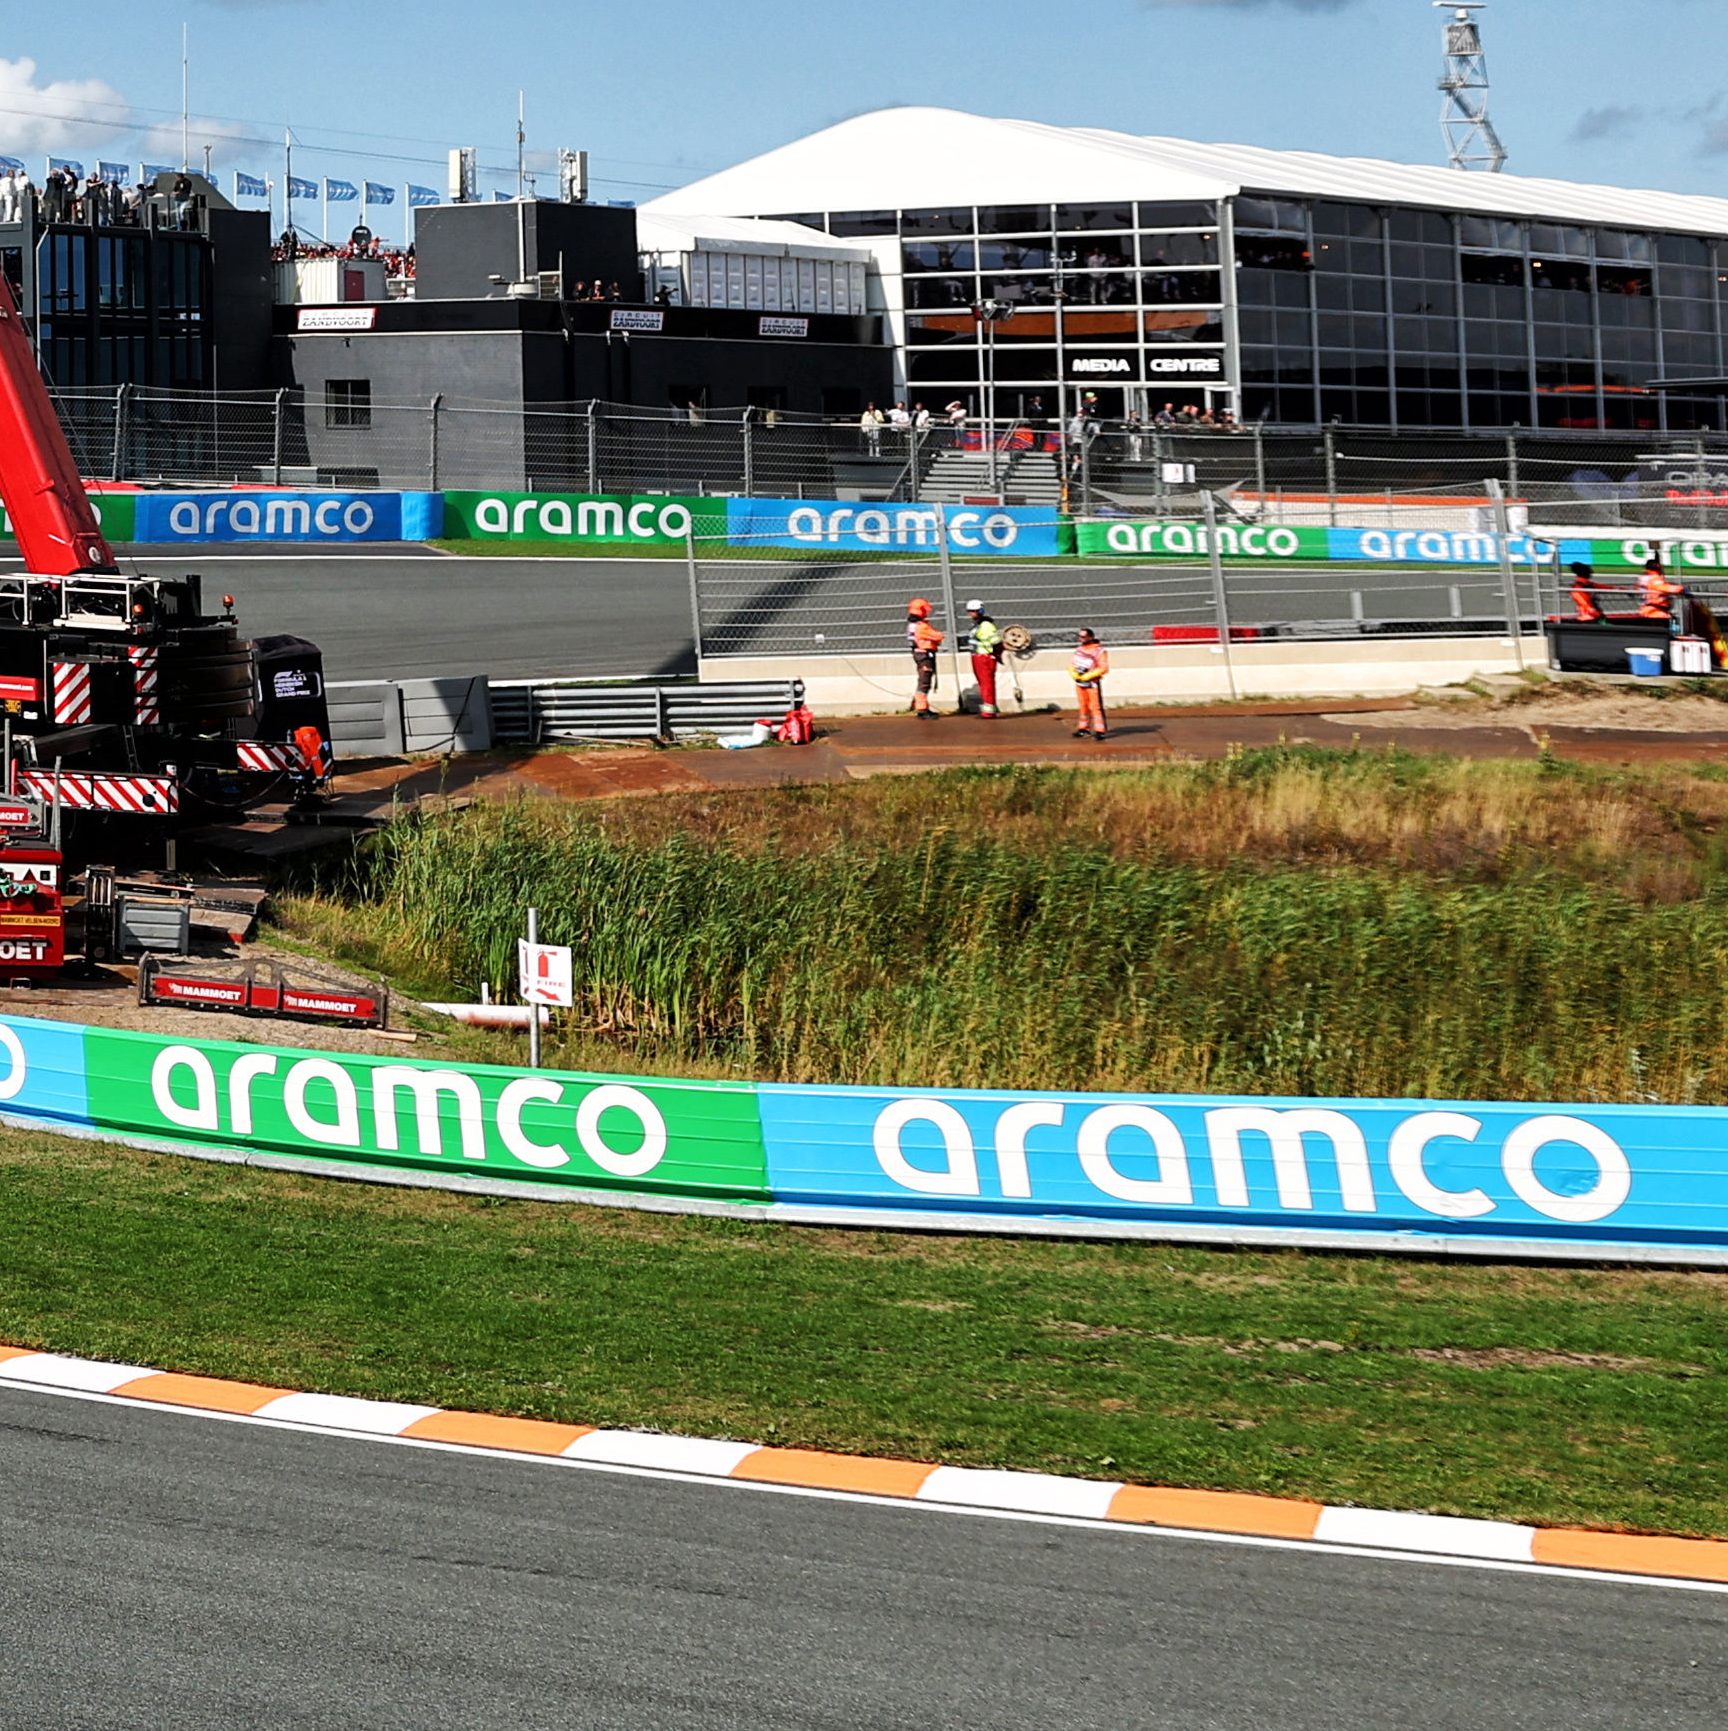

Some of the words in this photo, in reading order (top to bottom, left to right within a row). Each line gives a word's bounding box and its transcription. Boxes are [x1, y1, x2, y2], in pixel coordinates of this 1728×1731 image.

[613, 311, 661, 319] CIRCUIT
[613, 318, 661, 330] ZANDVOORT
[1072, 359, 1131, 372] MEDIA
[1150, 359, 1220, 372] CENTRE
[169, 499, 374, 535] aramco
[474, 497, 691, 539] aramco
[788, 506, 1018, 549] aramco
[1106, 523, 1299, 557] aramco
[1360, 529, 1556, 566] aramco
[182, 986, 241, 1001] MAMMOET
[298, 997, 357, 1013] MAMMOET
[150, 1043, 670, 1178] aramco
[874, 1096, 1632, 1224] aramco
